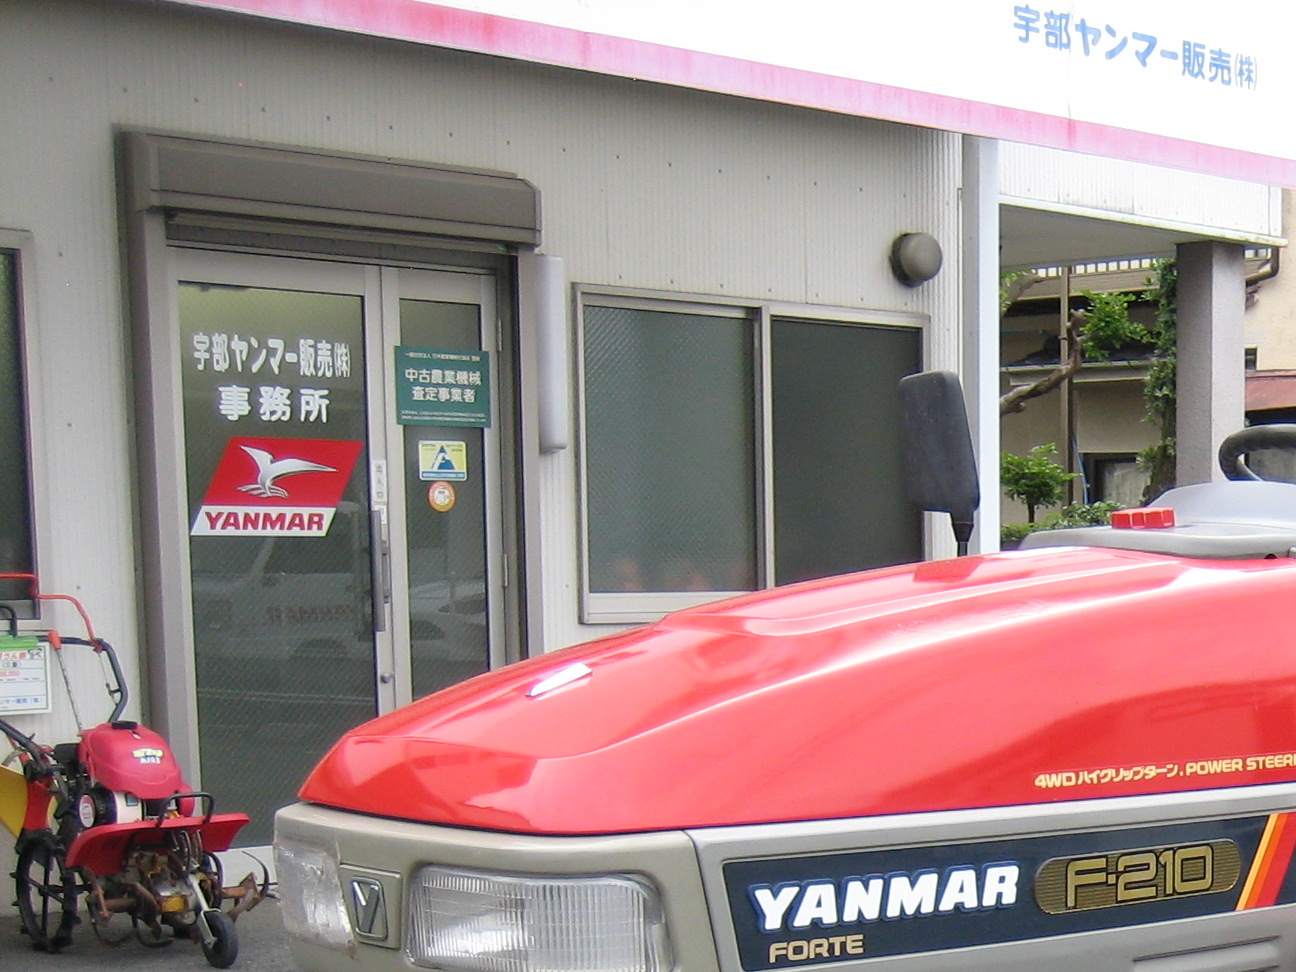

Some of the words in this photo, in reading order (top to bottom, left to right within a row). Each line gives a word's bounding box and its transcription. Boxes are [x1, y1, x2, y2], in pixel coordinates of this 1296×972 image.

[218, 384, 330, 424] 事務所
[204, 510, 325, 532] YANMAR
[1034, 771, 1076, 789] 4WD
[1185, 757, 1244, 776] POWER
[754, 862, 1021, 931] YANMAR
[768, 934, 865, 964] FORTE
